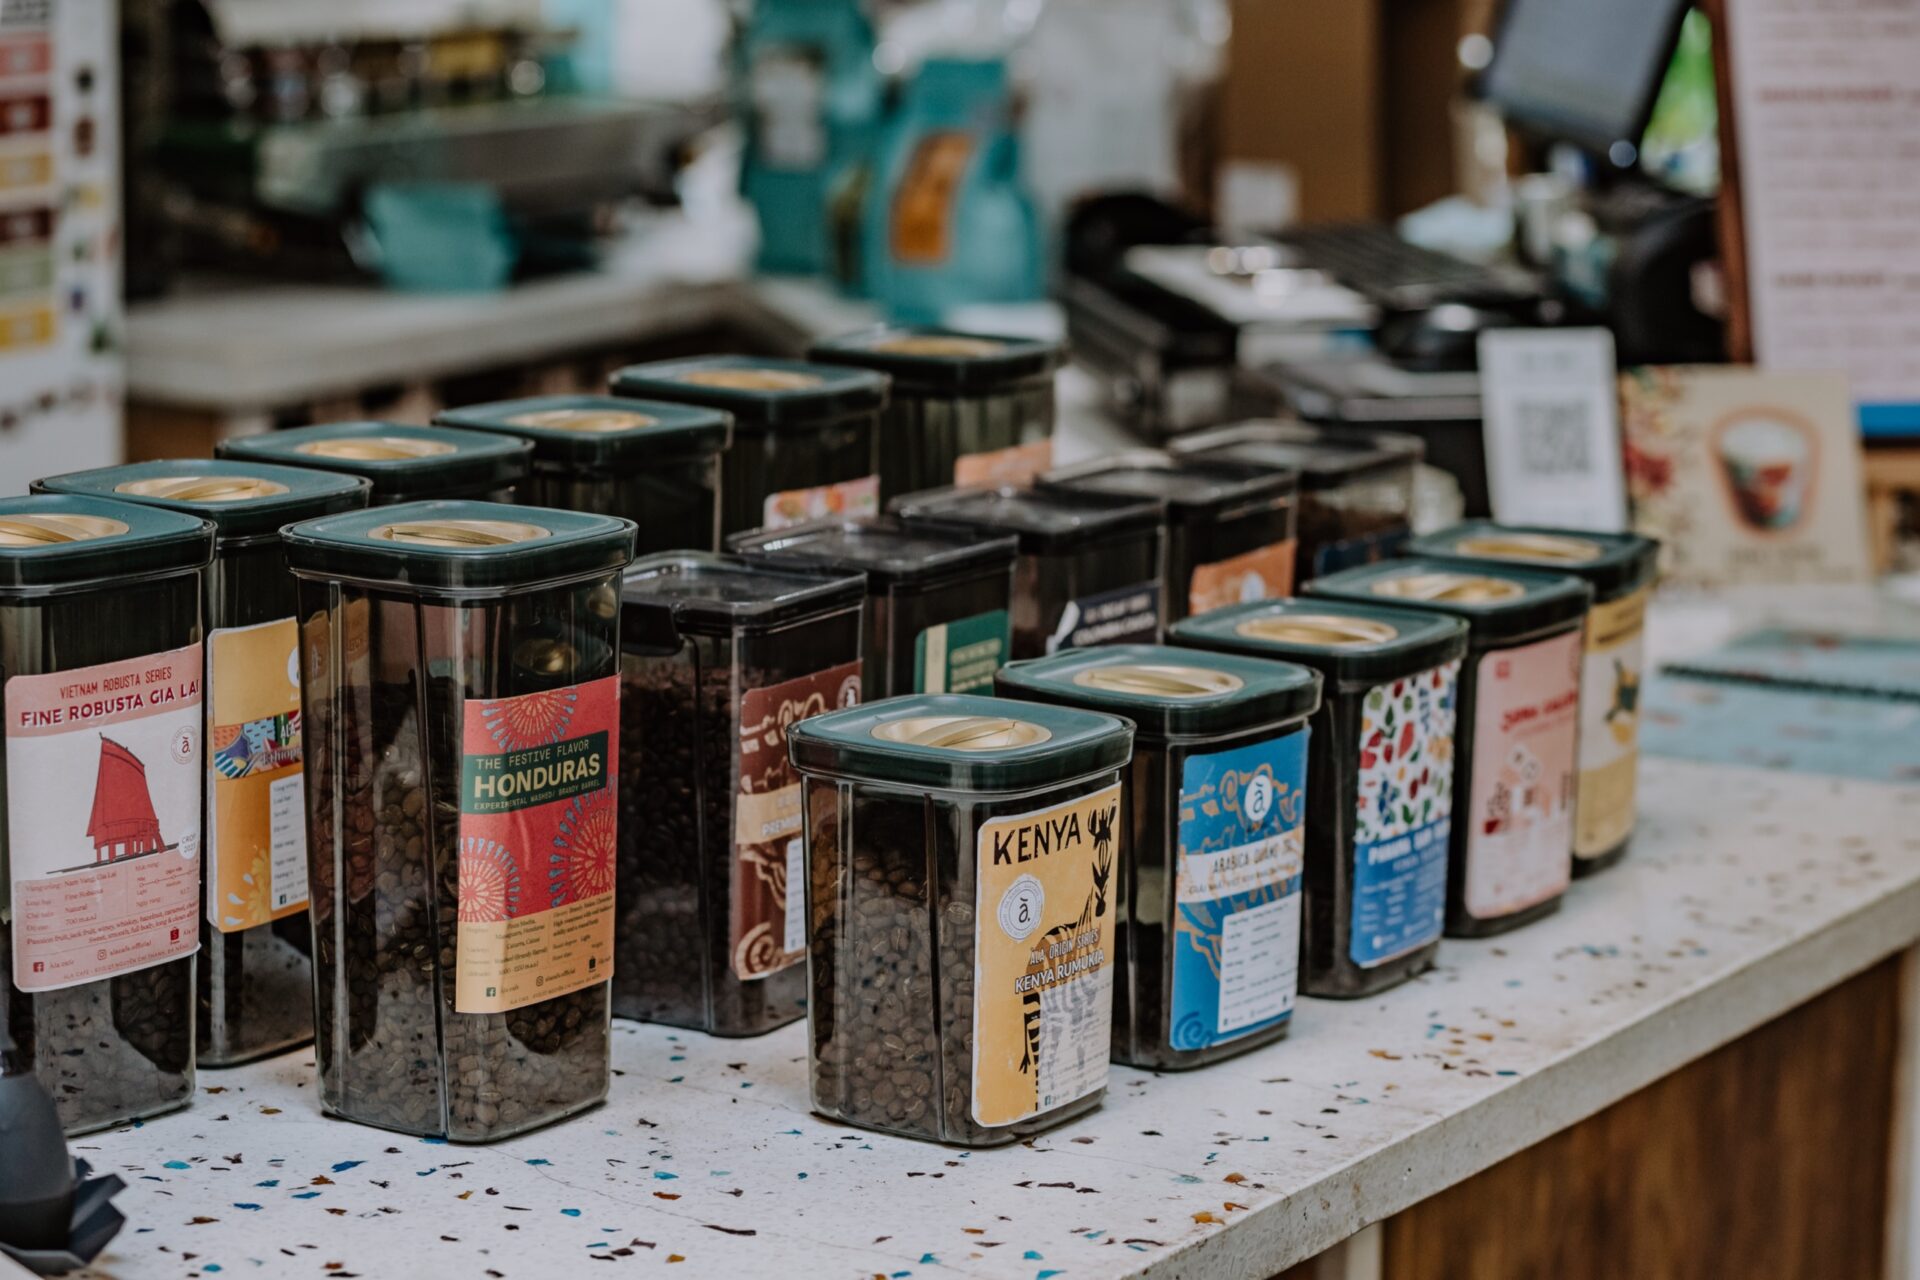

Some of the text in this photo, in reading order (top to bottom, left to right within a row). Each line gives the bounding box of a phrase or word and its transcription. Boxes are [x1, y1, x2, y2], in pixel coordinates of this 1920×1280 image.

[60, 667, 172, 699] VIETNAM ROBUSTA SERIES
[21, 709, 62, 726] FINE
[69, 694, 144, 720] ROBUSTA
[150, 687, 175, 704] GIA
[476, 739, 589, 770] THE FESTIVE FLAVOR
[474, 753, 600, 798] HONDURAS
[474, 797, 528, 810] EXPERIMENTAL
[558, 784, 579, 796] BRANDY
[581, 779, 600, 790] BARREL
[993, 812, 1081, 866] KENYA
[1049, 939, 1073, 959] ORIGIN
[1077, 928, 1099, 949] SERIES
[1015, 948, 1105, 994] KENYA RUMUKIA
